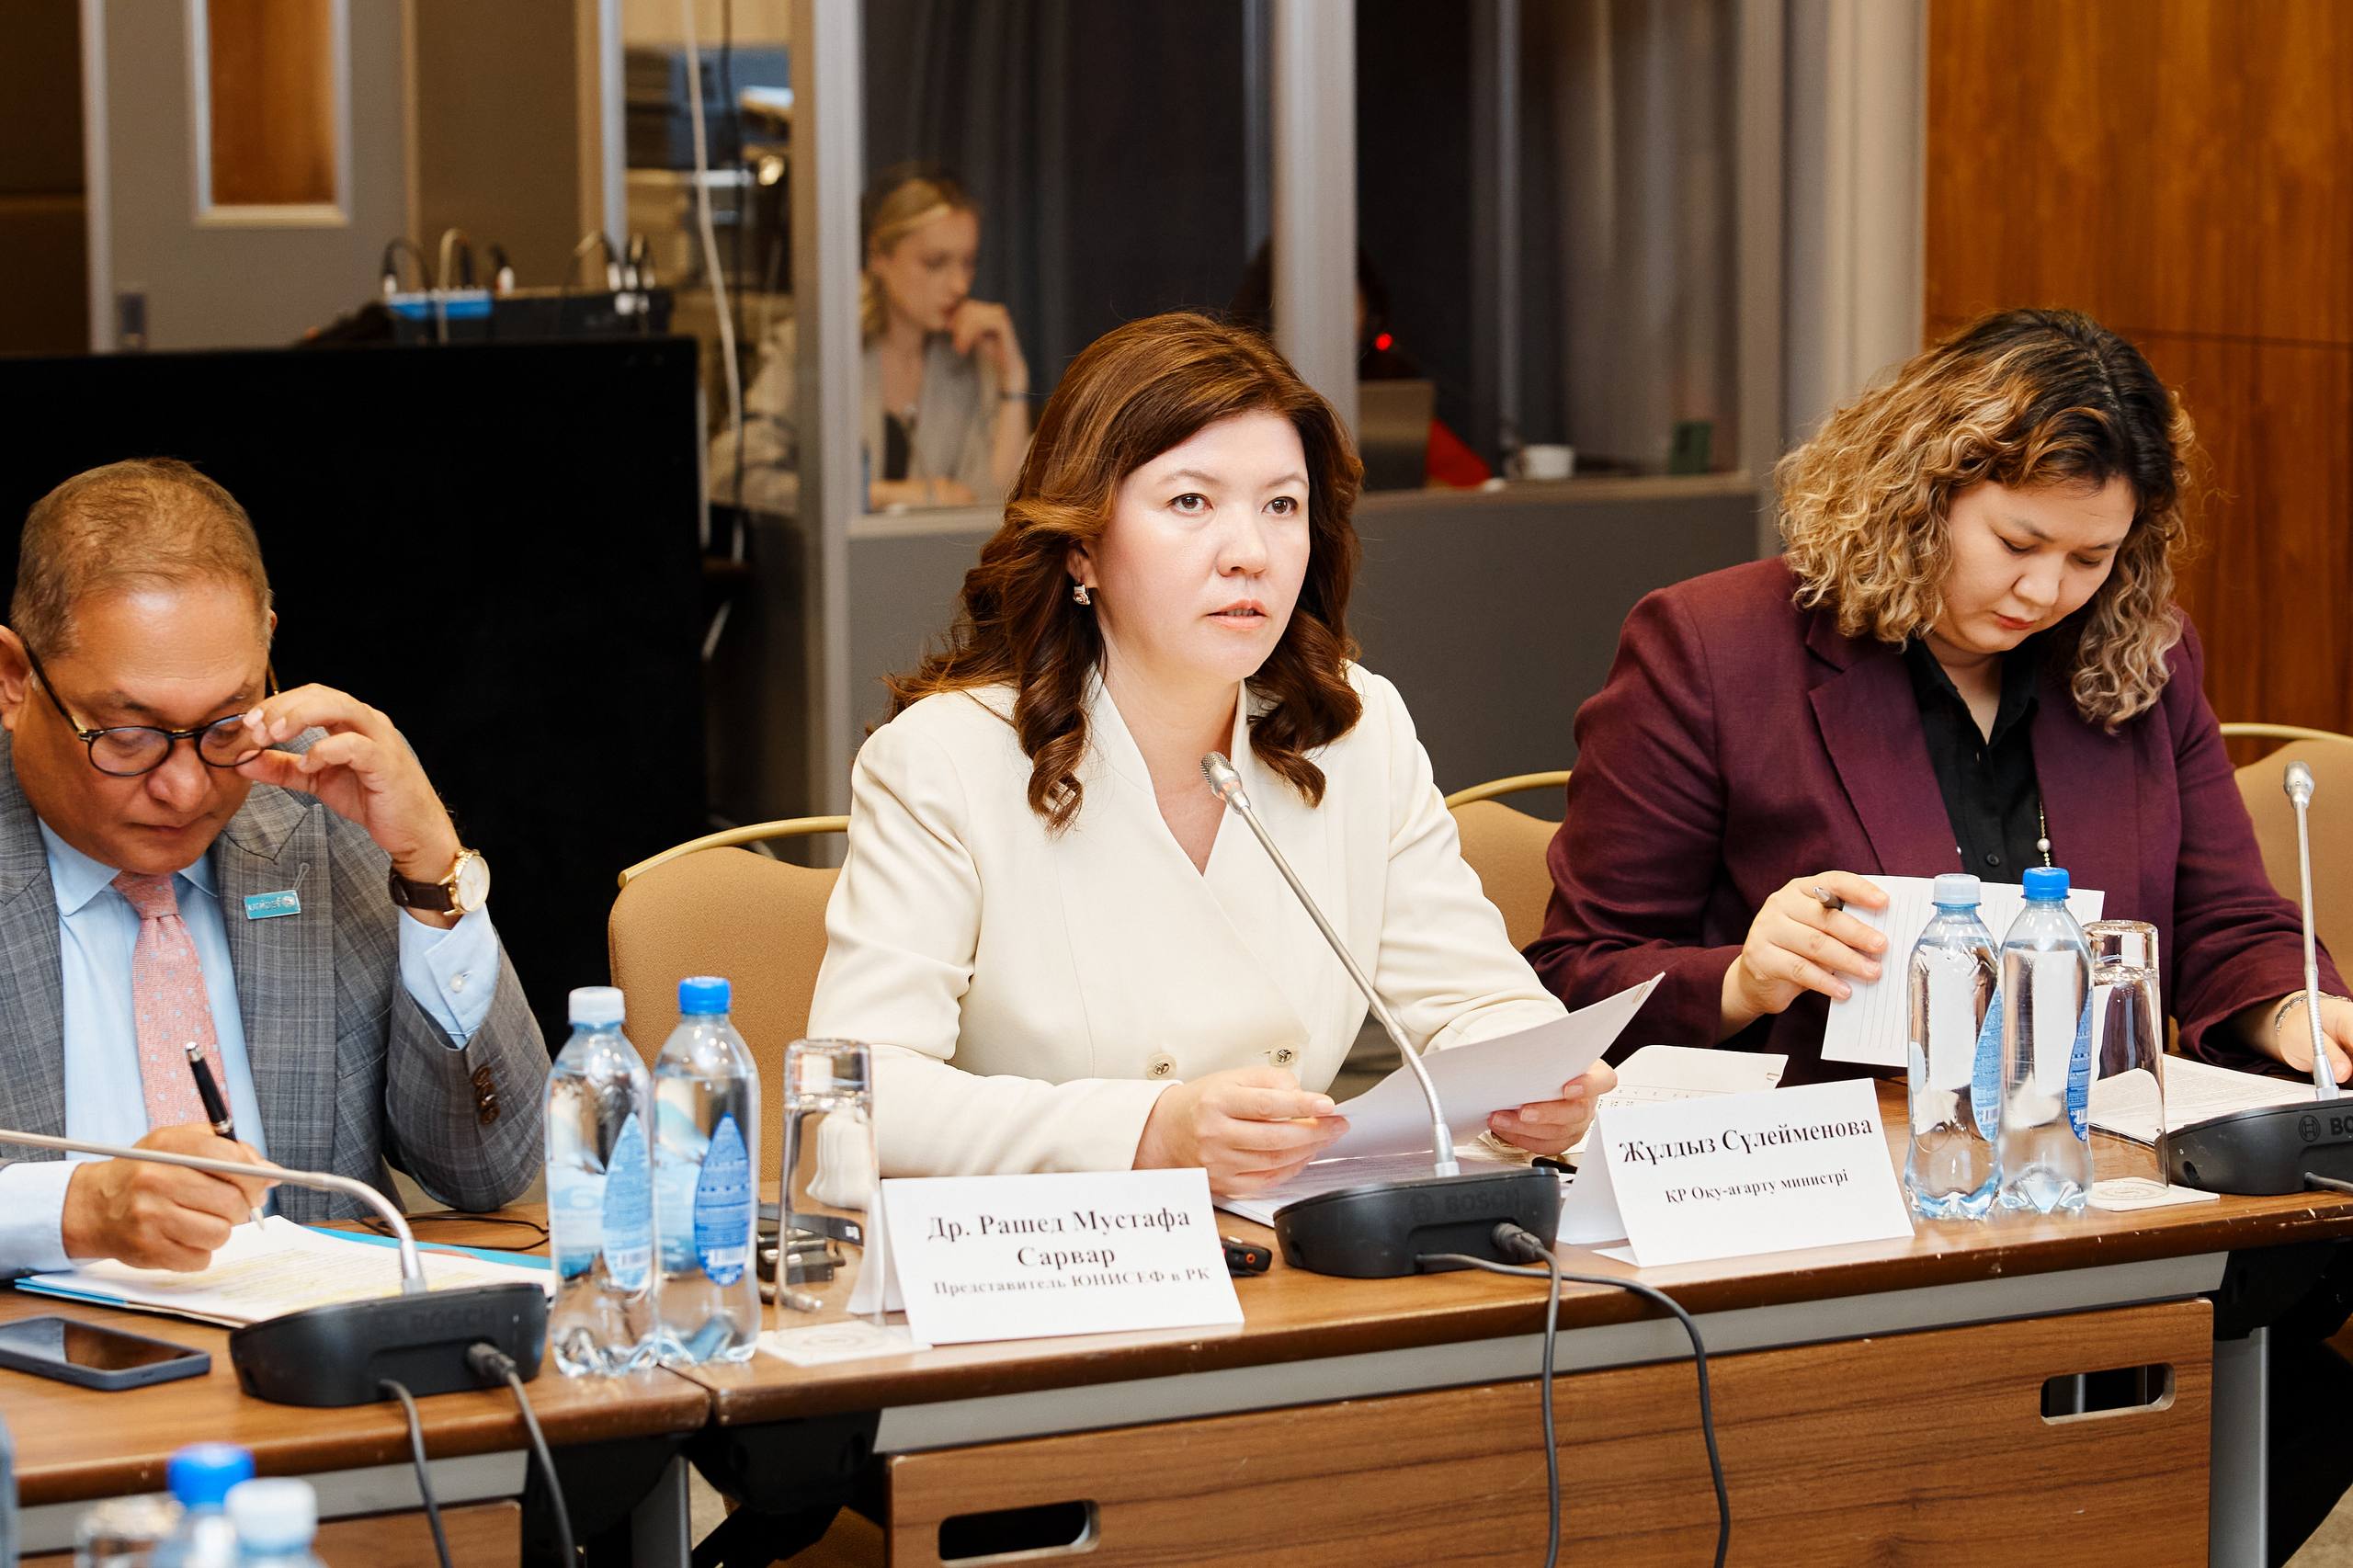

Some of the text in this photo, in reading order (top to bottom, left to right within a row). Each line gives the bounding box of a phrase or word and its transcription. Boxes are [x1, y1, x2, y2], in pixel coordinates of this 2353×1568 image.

[1722, 1119, 1874, 1155] Сүлейменова
[1779, 1168, 1849, 1190] министрі
[926, 1206, 1191, 1244] Др. Рашед Мустафа
[1016, 1245, 1116, 1271] Сарвар
[933, 1266, 1211, 1298] Представитель ЮНИСЕФ в РК
